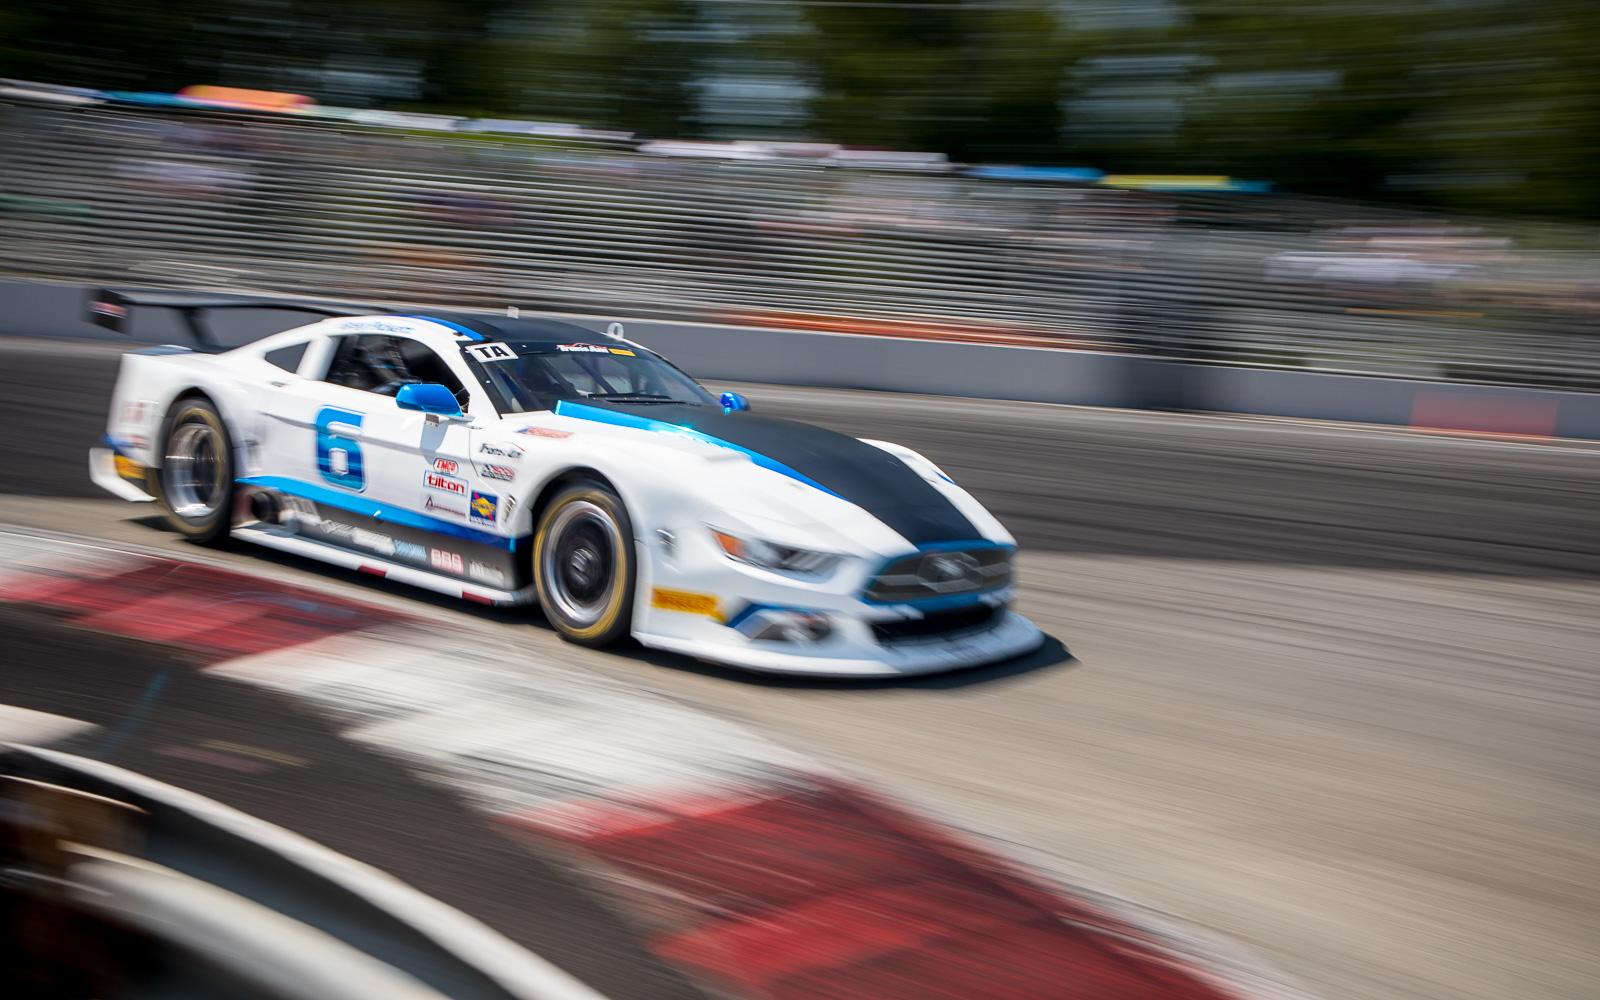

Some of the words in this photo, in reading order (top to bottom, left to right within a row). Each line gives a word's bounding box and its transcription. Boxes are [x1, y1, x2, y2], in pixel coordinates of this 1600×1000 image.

[474, 345, 510, 359] TA
[314, 404, 367, 493] 6
[426, 474, 465, 494] tilton
